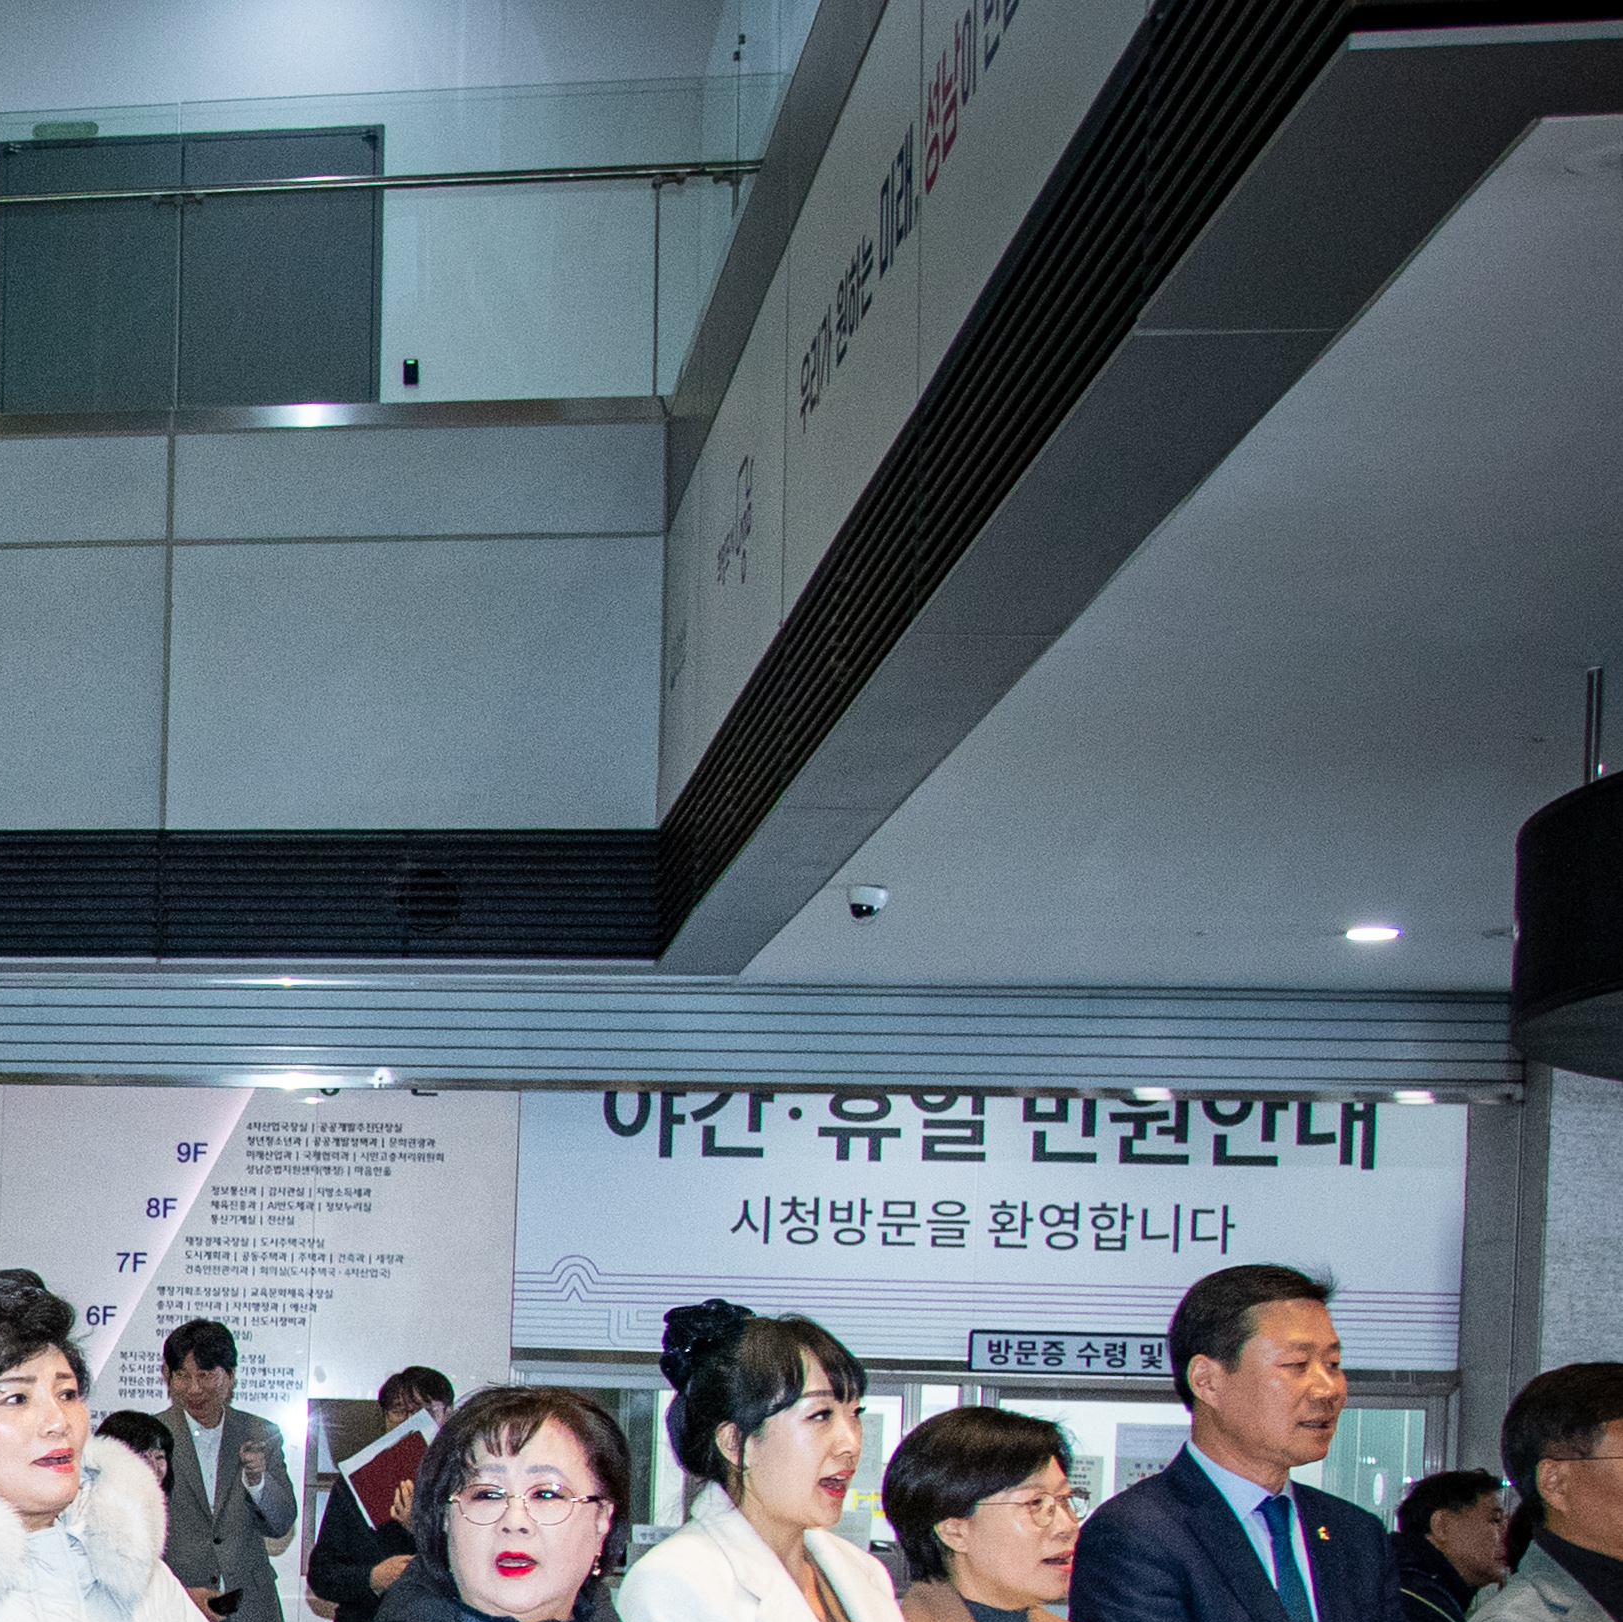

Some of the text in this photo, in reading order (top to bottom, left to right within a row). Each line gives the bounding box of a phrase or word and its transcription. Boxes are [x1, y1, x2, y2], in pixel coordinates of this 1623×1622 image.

[176, 1142, 208, 1163] 9F
[146, 1198, 178, 1219] 8F
[729, 1197, 1237, 1255] 시청방문을 환영합니다
[115, 1252, 148, 1273] 7F
[86, 1305, 118, 1326] 6F
[987, 1340, 1066, 1367] 방문증
[1076, 1341, 1128, 1369] 수령
